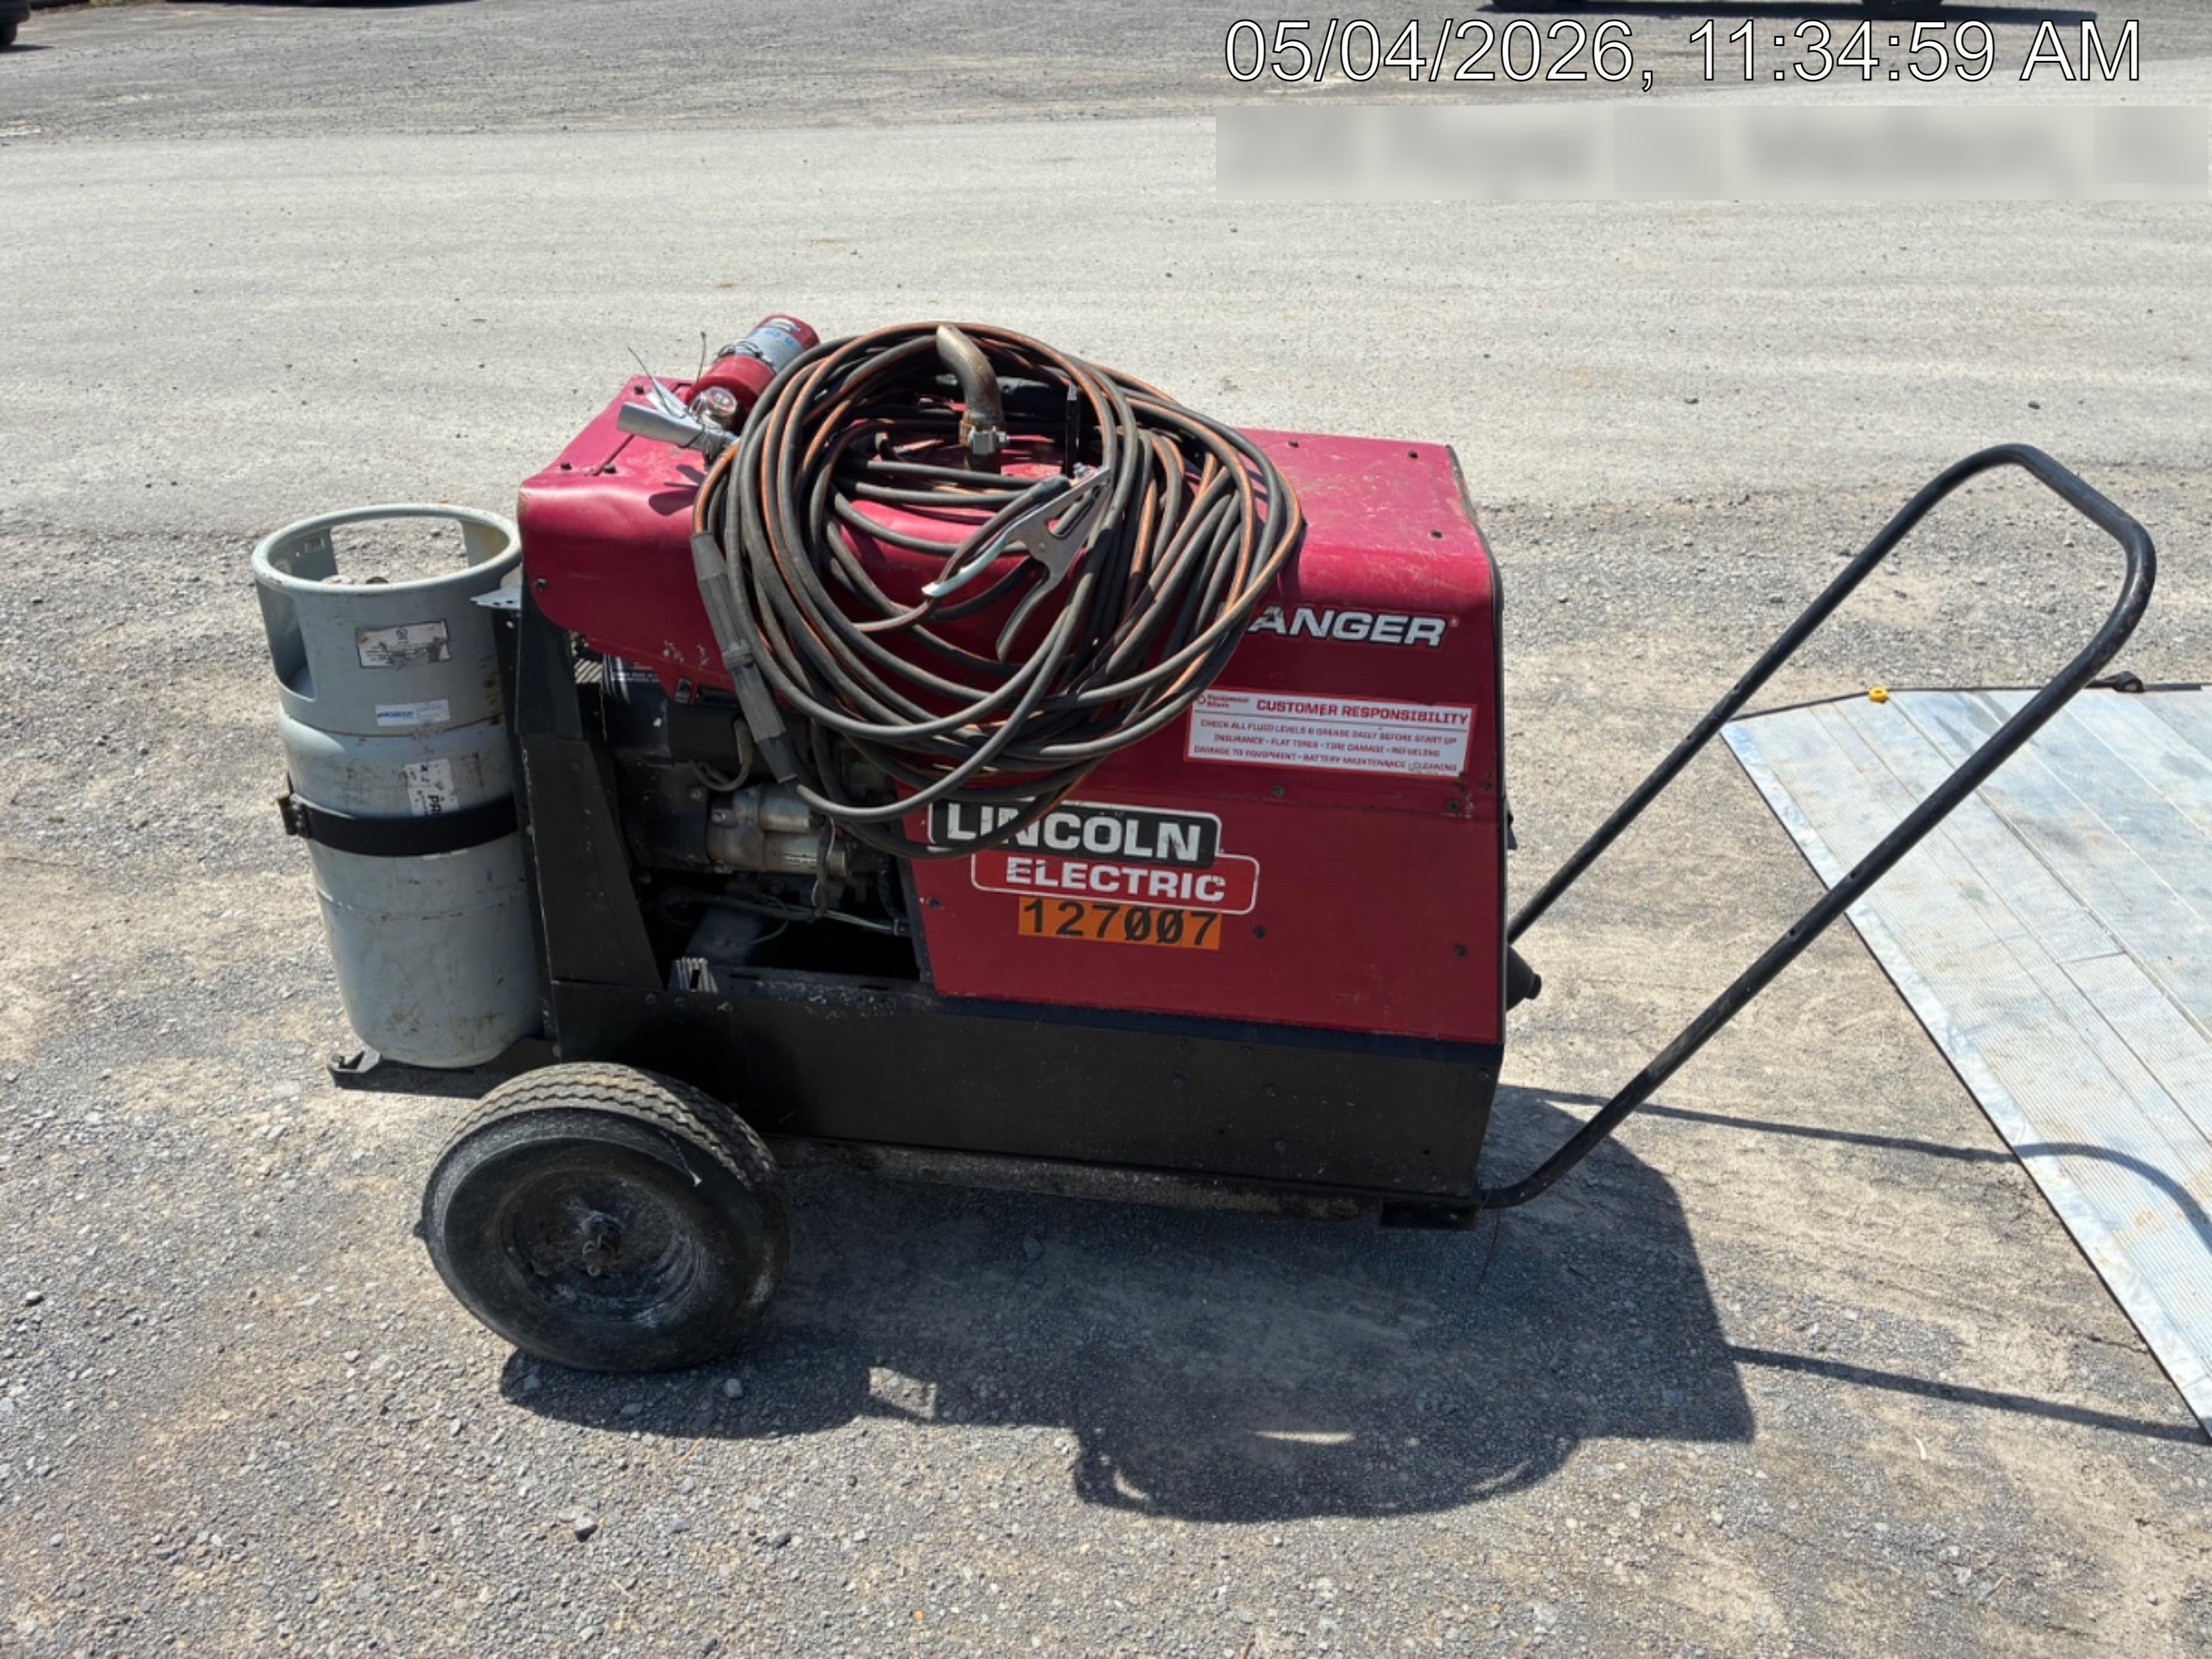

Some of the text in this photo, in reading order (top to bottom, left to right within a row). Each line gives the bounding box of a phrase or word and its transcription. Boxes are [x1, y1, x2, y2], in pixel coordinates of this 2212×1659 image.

[1229, 606, 1446, 646] ANGER
[1257, 699, 1468, 724] CUSTOMER RESPONSIBILITY
[1215, 734, 1440, 757] INSURANCE FLAT TIRES TIRE DAMAGE REFUELING
[1248, 723, 1273, 732] FLUID
[1276, 725, 1305, 734] LEVELS
[1316, 728, 1350, 738] GREASE
[1352, 730, 1377, 739] DAILY
[1379, 732, 1412, 742] BEFORE
[1415, 735, 1442, 744] START
[1194, 745, 1230, 755] DAMAGE
[1245, 750, 1296, 760] EQUIPMENT
[1303, 754, 1341, 764] BATTERY
[1343, 756, 1405, 768] MAINTENANCE
[1413, 761, 1457, 771] CLEANING
[947, 802, 1201, 861] LINCOLN
[1006, 857, 1226, 902] ELECTRIC
[1023, 900, 1218, 946] 127007
